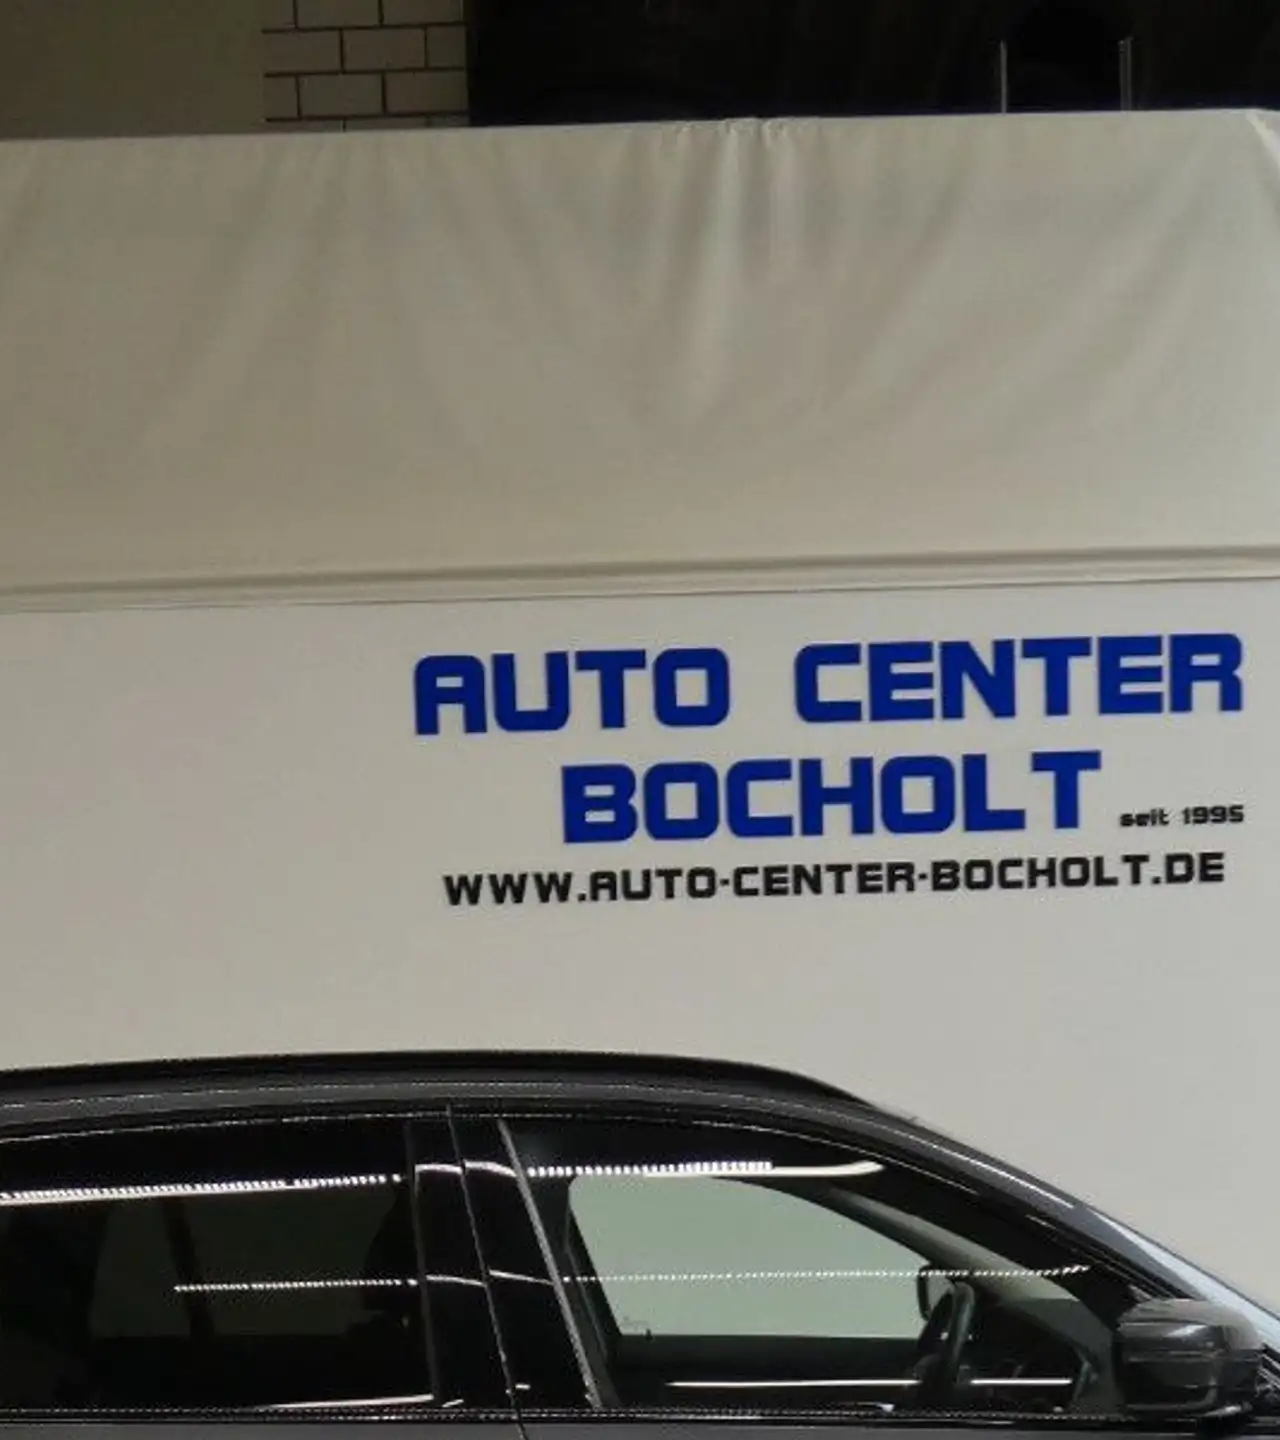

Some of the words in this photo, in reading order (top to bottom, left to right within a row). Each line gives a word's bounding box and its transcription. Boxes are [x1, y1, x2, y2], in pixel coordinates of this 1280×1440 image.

[415, 648, 730, 735] AUTO
[794, 633, 1244, 722] CENTER
[562, 751, 1102, 844] BOCHOLT
[1120, 809, 1170, 828] seit
[1181, 804, 1245, 825] 1995
[443, 852, 1225, 907] WWW.AUTO-CENTER-BOCHOLT.DE
